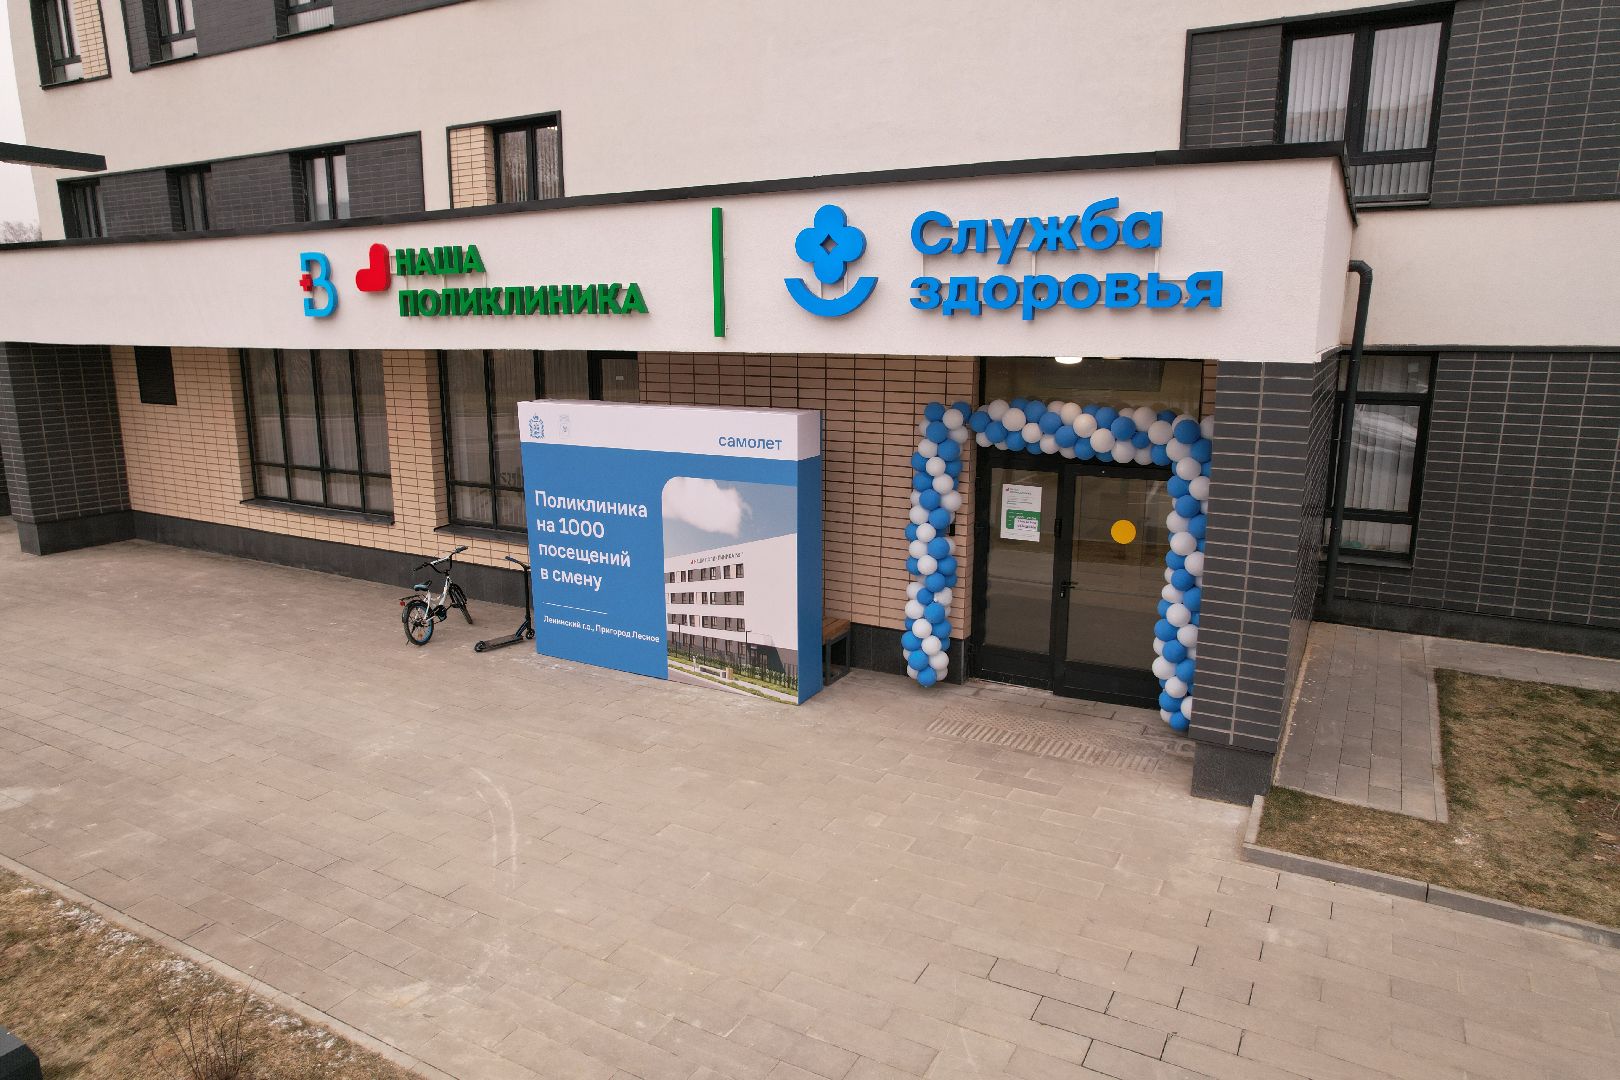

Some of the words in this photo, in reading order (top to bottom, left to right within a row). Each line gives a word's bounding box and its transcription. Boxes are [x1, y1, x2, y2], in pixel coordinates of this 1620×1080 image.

[910, 196, 1164, 265] Служба
[395, 244, 486, 276] НАША
[398, 282, 650, 318] ПОЛИКЛИНИКА
[909, 270, 1224, 321] здоровья
[718, 434, 783, 451] самолет
[534, 489, 648, 518] Поликлиника
[536, 518, 556, 533] на
[558, 517, 605, 539] 1000
[538, 543, 631, 567] посещений
[540, 567, 549, 580] в
[552, 569, 602, 592] смену
[543, 615, 581, 629] Ленинский
[595, 623, 631, 638] Пригород
[631, 631, 660, 643] Лесное
